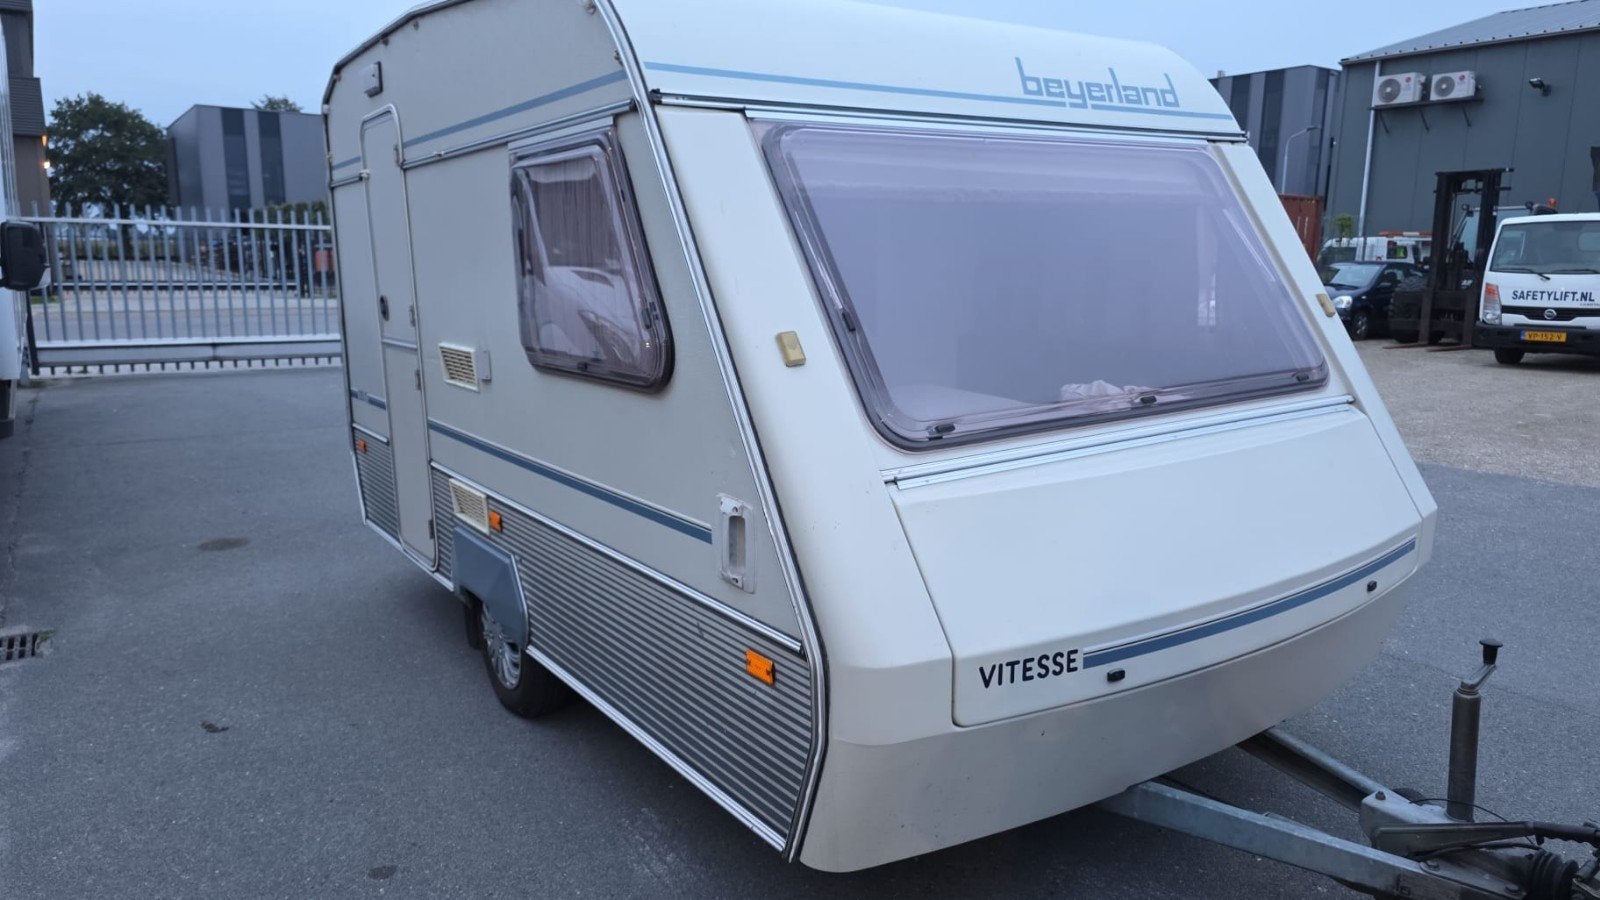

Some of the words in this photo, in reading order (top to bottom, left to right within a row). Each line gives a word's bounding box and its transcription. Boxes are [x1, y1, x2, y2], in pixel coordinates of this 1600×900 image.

[1014, 56, 1180, 109] beyerland
[1512, 290, 1595, 302] SAFETYLIFT.NL
[979, 649, 1079, 689] VITESSE
